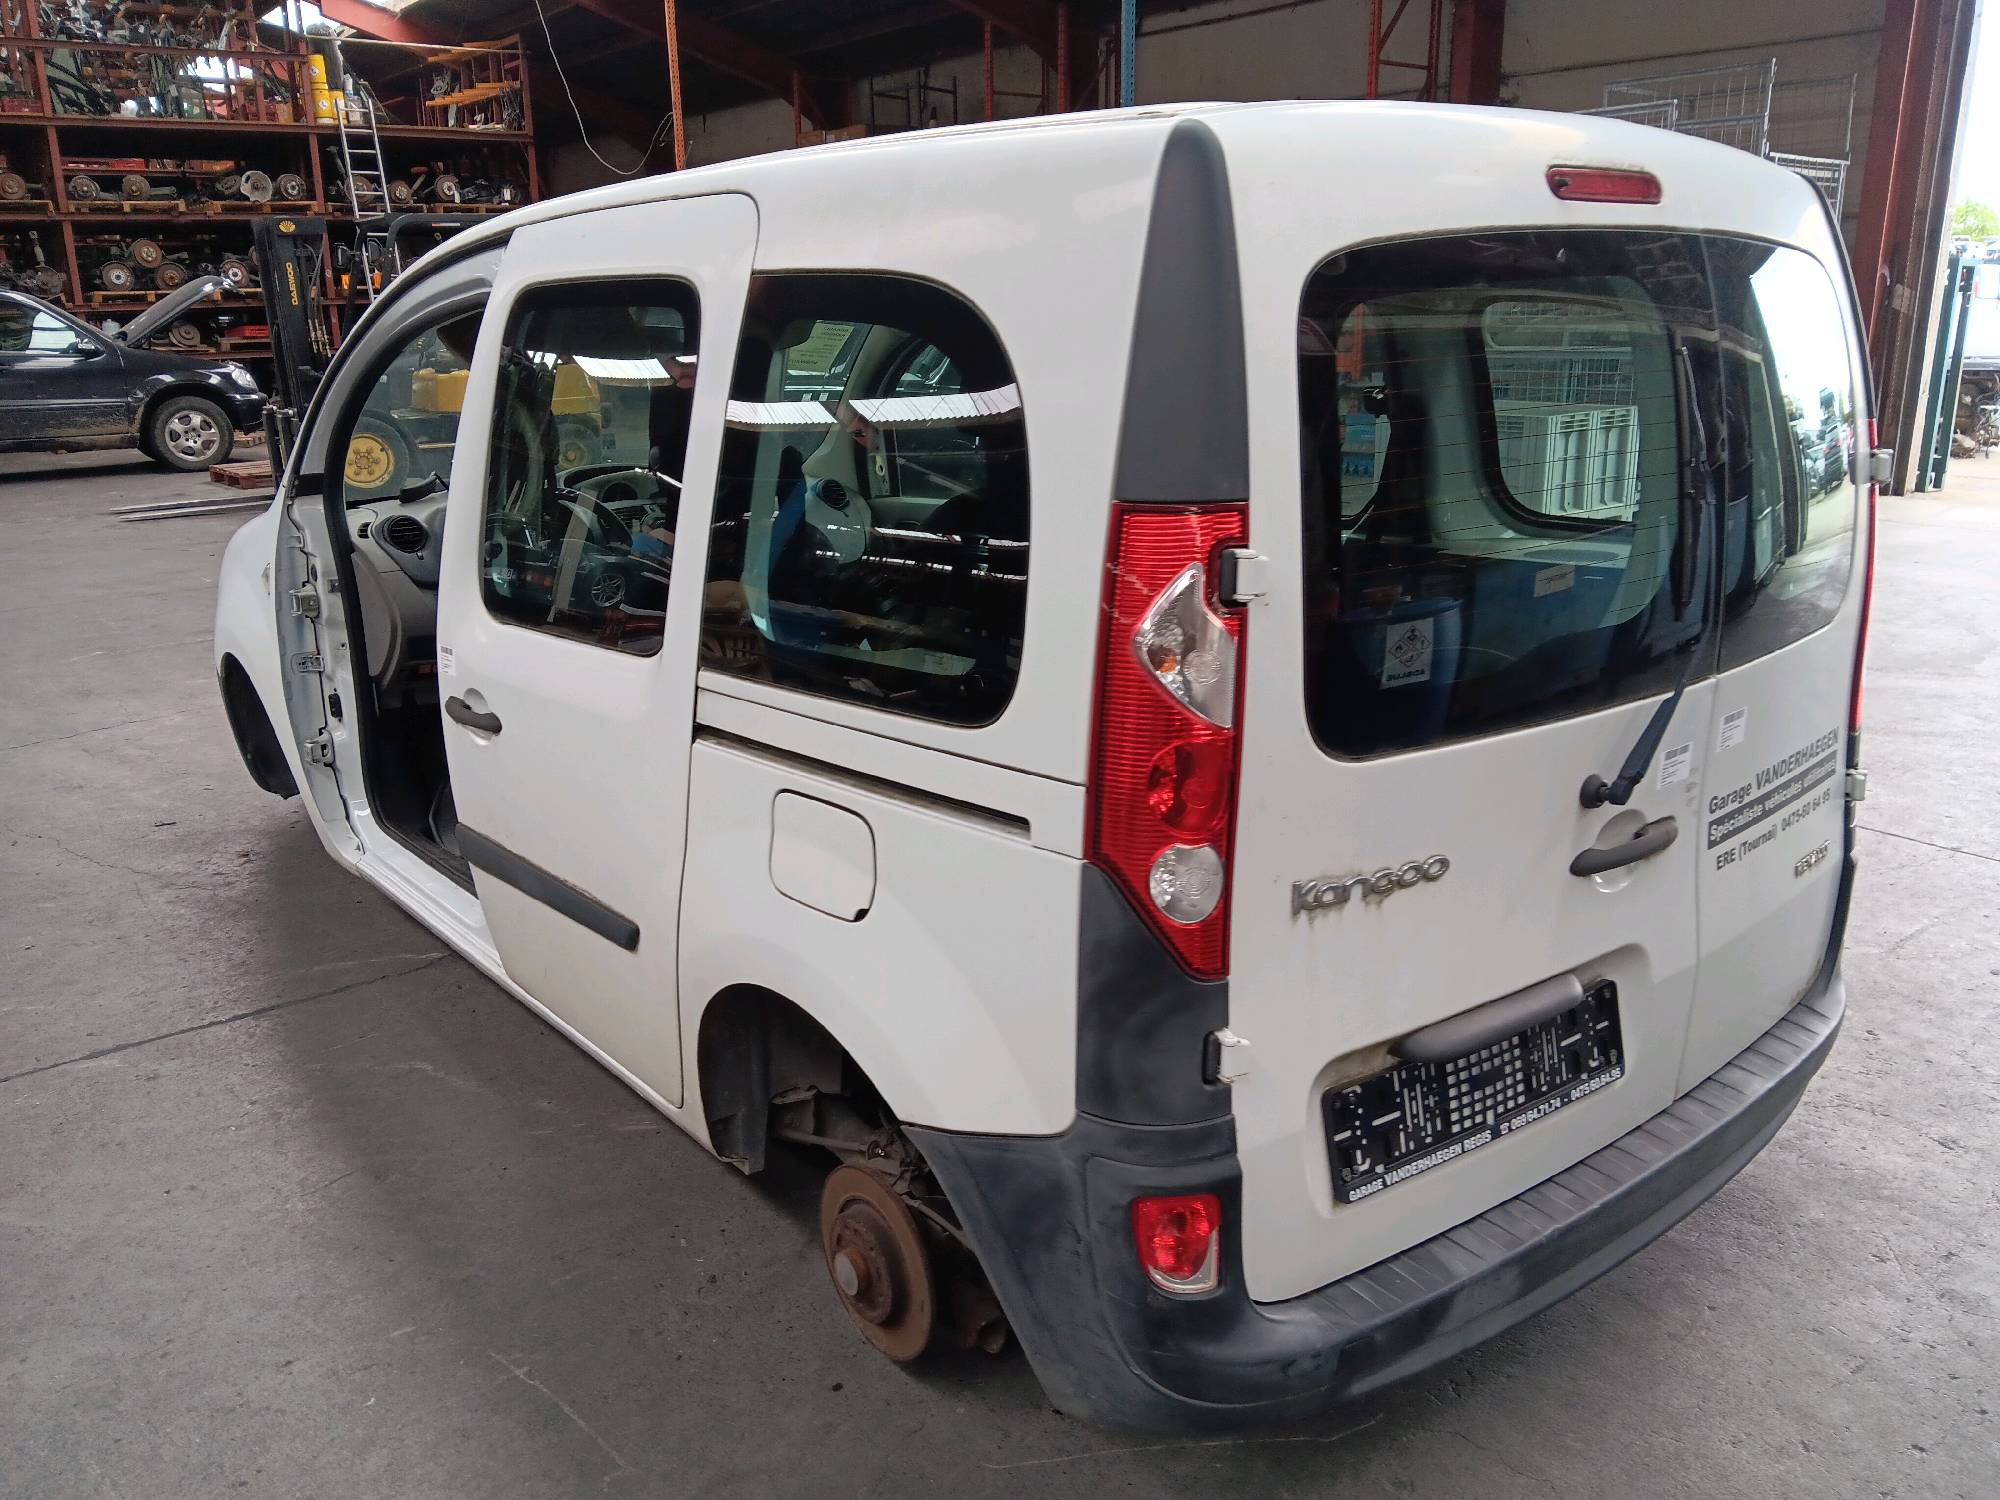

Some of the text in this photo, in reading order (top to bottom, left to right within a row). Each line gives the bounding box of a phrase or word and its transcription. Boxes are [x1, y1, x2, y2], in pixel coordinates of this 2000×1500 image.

[285, 262, 298, 305] DAEWOO
[1709, 782, 1753, 815] Garage
[1756, 726, 1839, 791] VANDERHAEGEN
[1291, 854, 1450, 917] Kangoo
[1716, 847, 1737, 871] ERE
[1349, 1177, 1384, 1201] GARAGE
[1384, 1142, 1463, 1186] VANDERHAEGEN
[1463, 1129, 1492, 1152] REGIS
